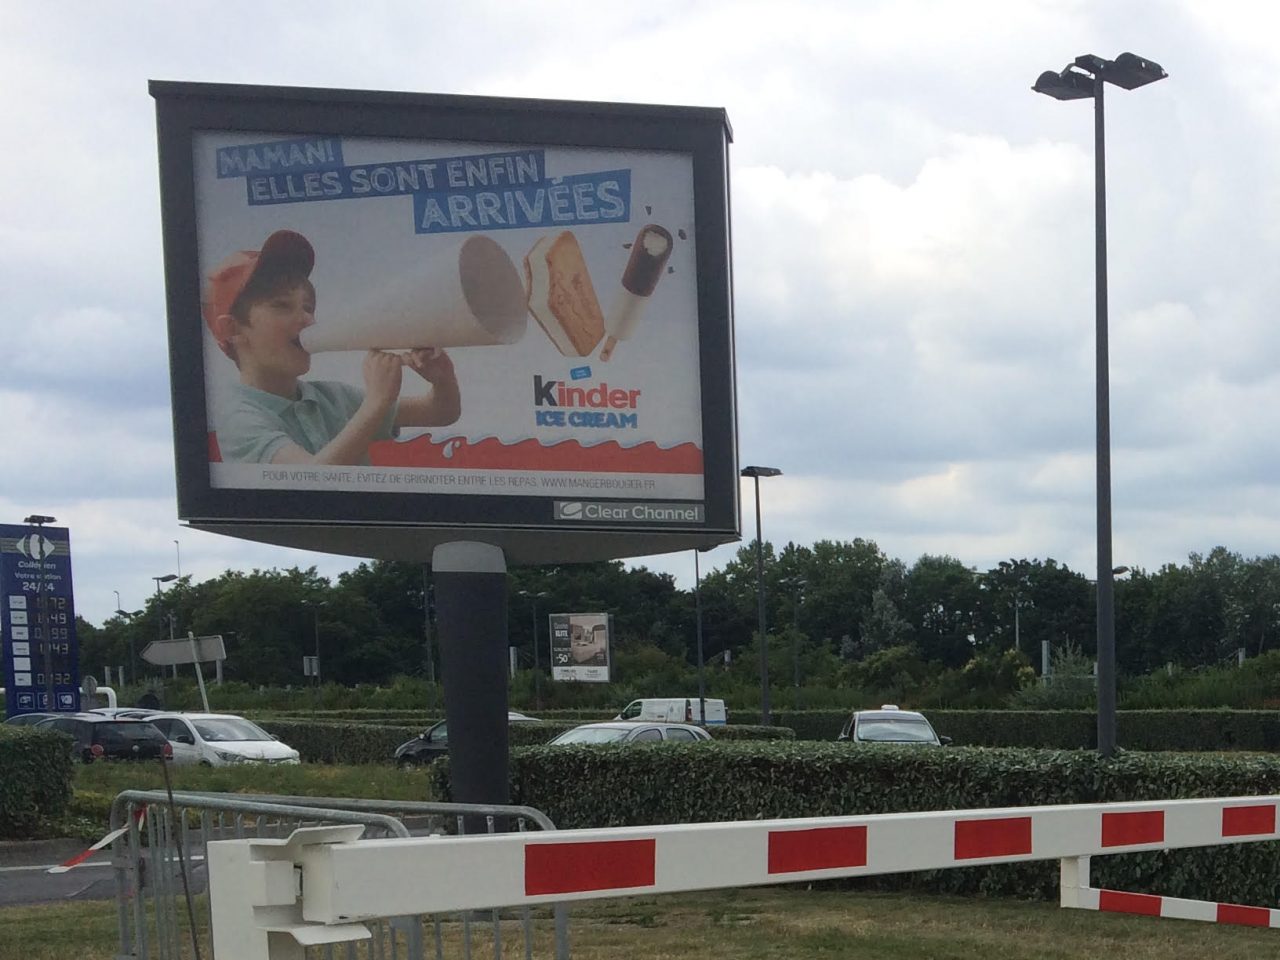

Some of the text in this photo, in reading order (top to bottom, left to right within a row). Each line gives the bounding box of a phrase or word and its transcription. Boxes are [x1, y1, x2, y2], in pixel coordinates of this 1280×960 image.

[219, 139, 335, 175] MAMAN!
[251, 154, 539, 201] ELLES SONT ENFIN
[421, 176, 625, 229] ARRIVÉES
[535, 410, 639, 429] ICE CREAM
[262, 470, 288, 481] POUR
[290, 471, 319, 482] VOTRE
[389, 473, 401, 483] DE
[404, 473, 455, 485] GRIGNOTER
[458, 475, 487, 486] ENTRE
[490, 475, 506, 486] LES
[585, 504, 699, 521] Clear Channel
[14, 571, 35, 579] Votre
